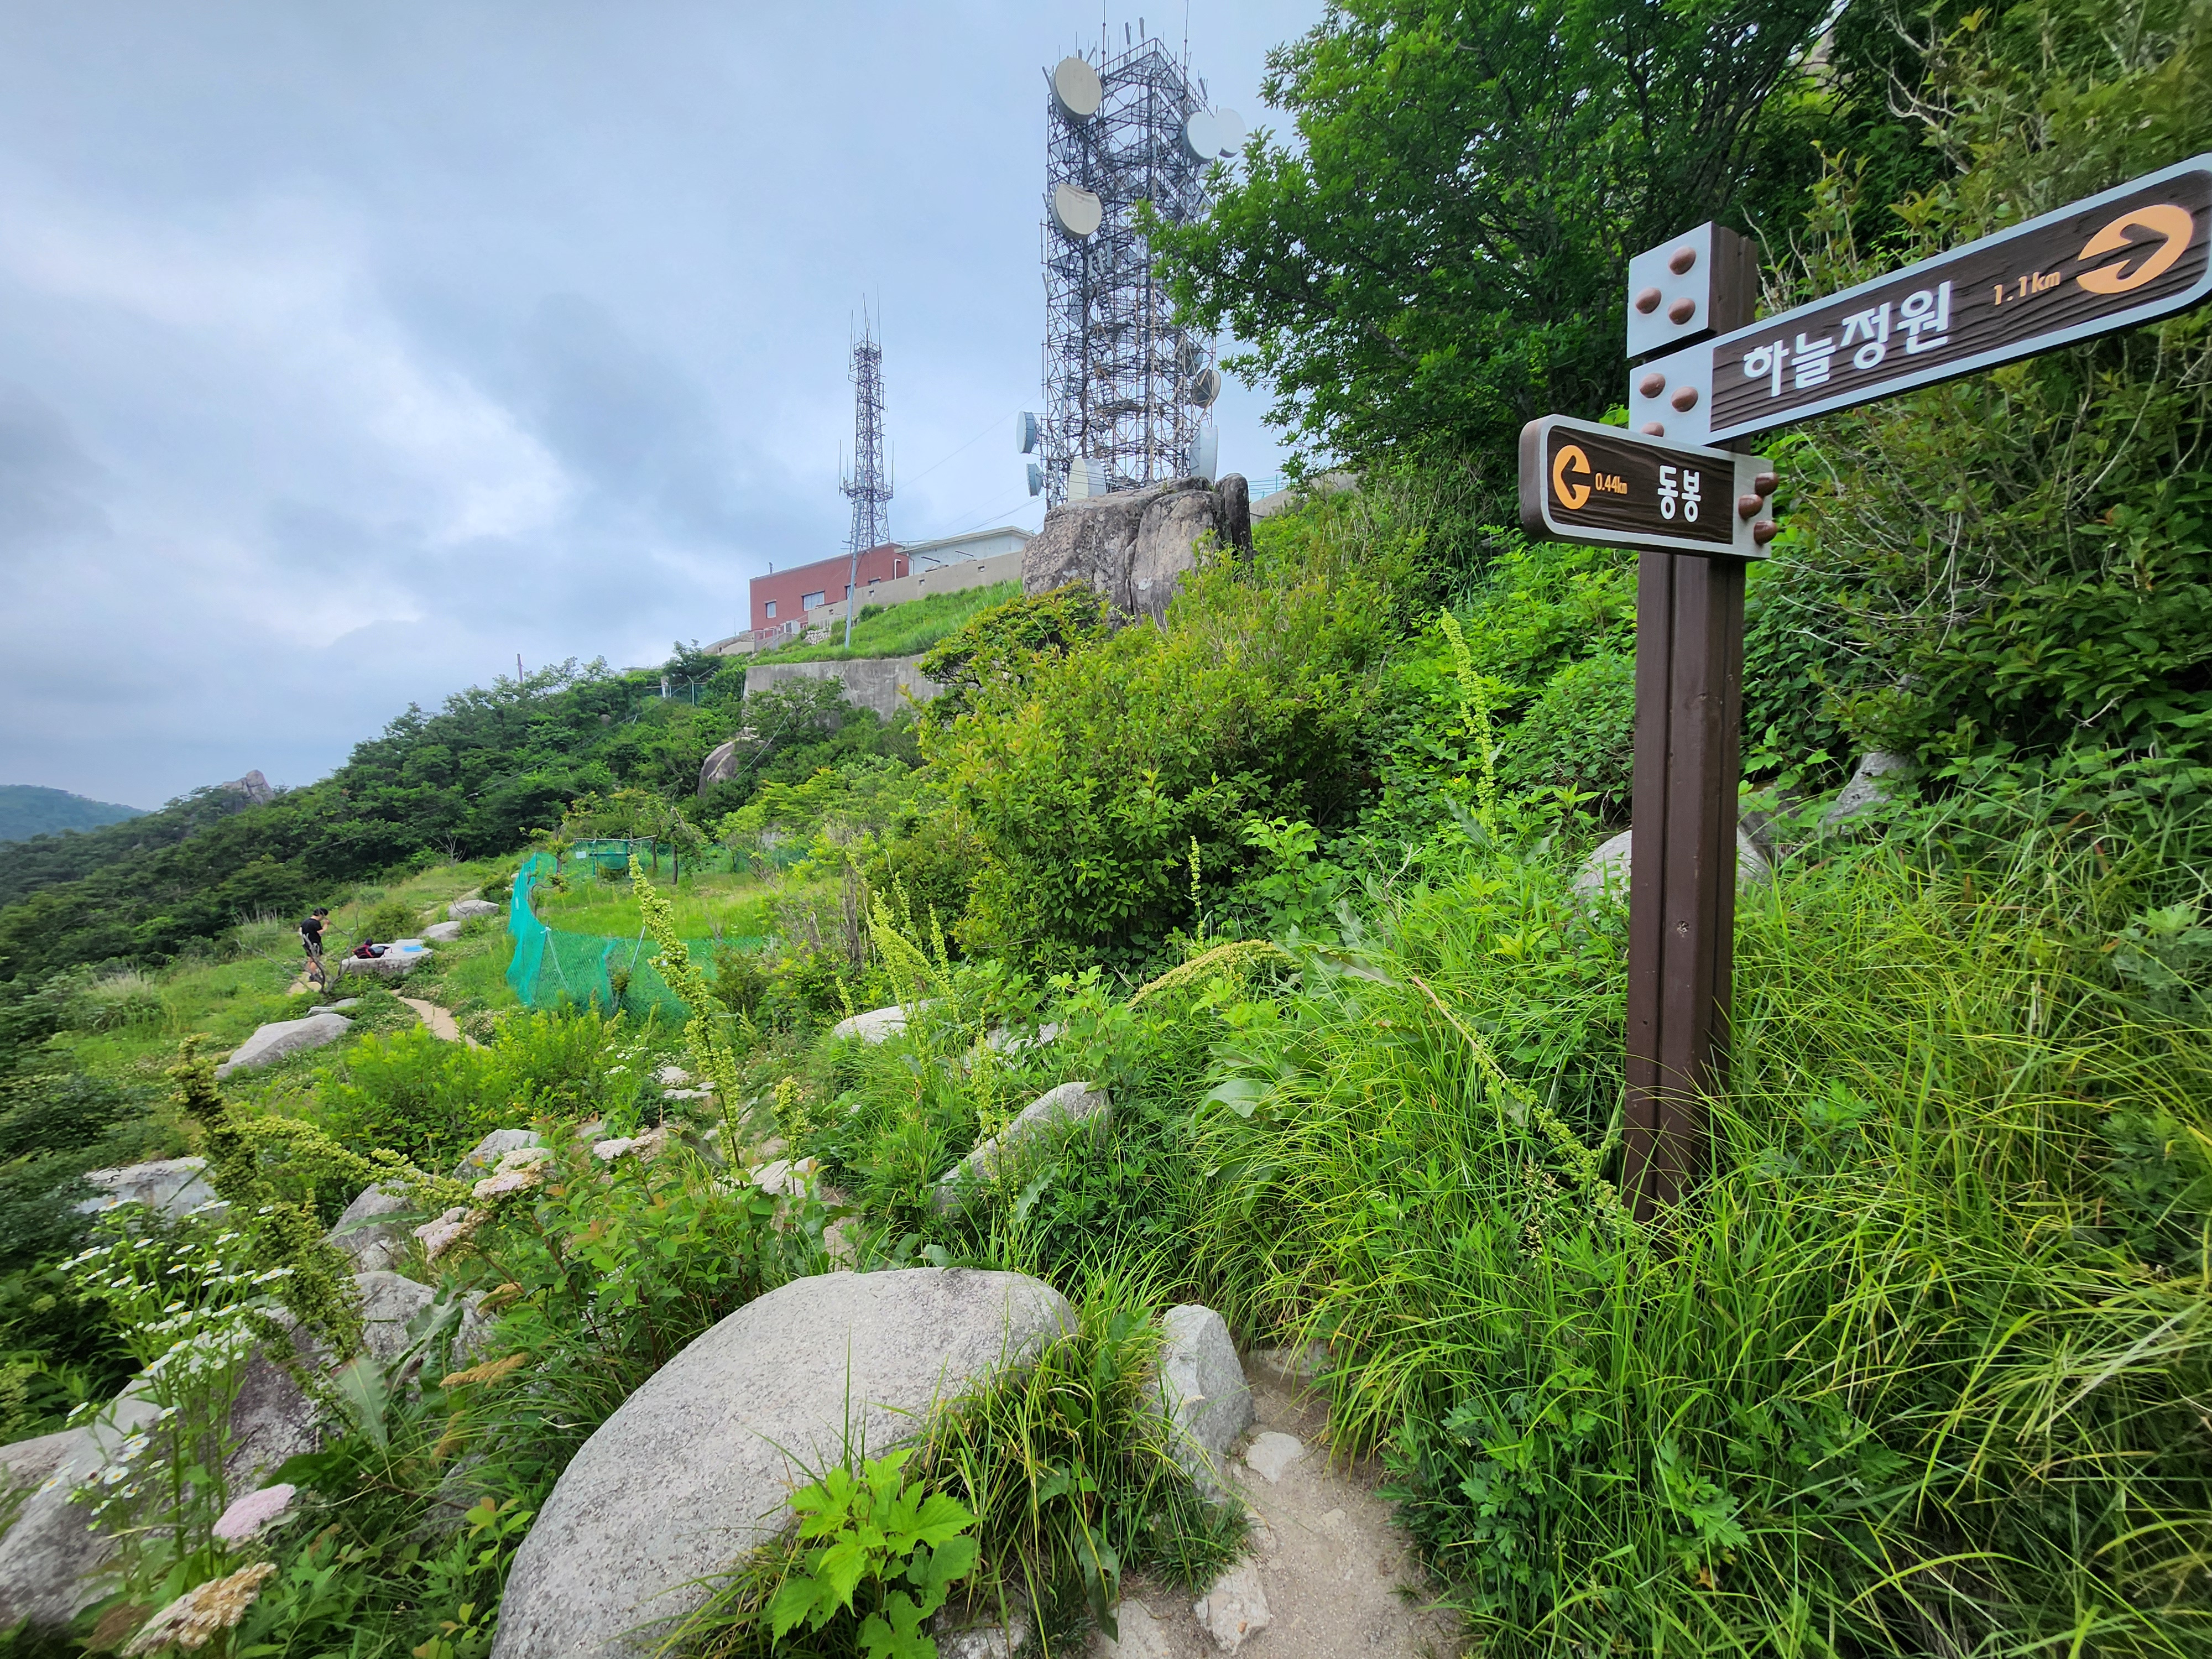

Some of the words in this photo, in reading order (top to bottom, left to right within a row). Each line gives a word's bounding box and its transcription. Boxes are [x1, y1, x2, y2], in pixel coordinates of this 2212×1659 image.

[1743, 280, 1953, 397] 하늘정원
[1994, 271, 2060, 305] 1.1km
[1595, 472, 1627, 494] 0.44km
[1657, 465, 1702, 523] 동봉
